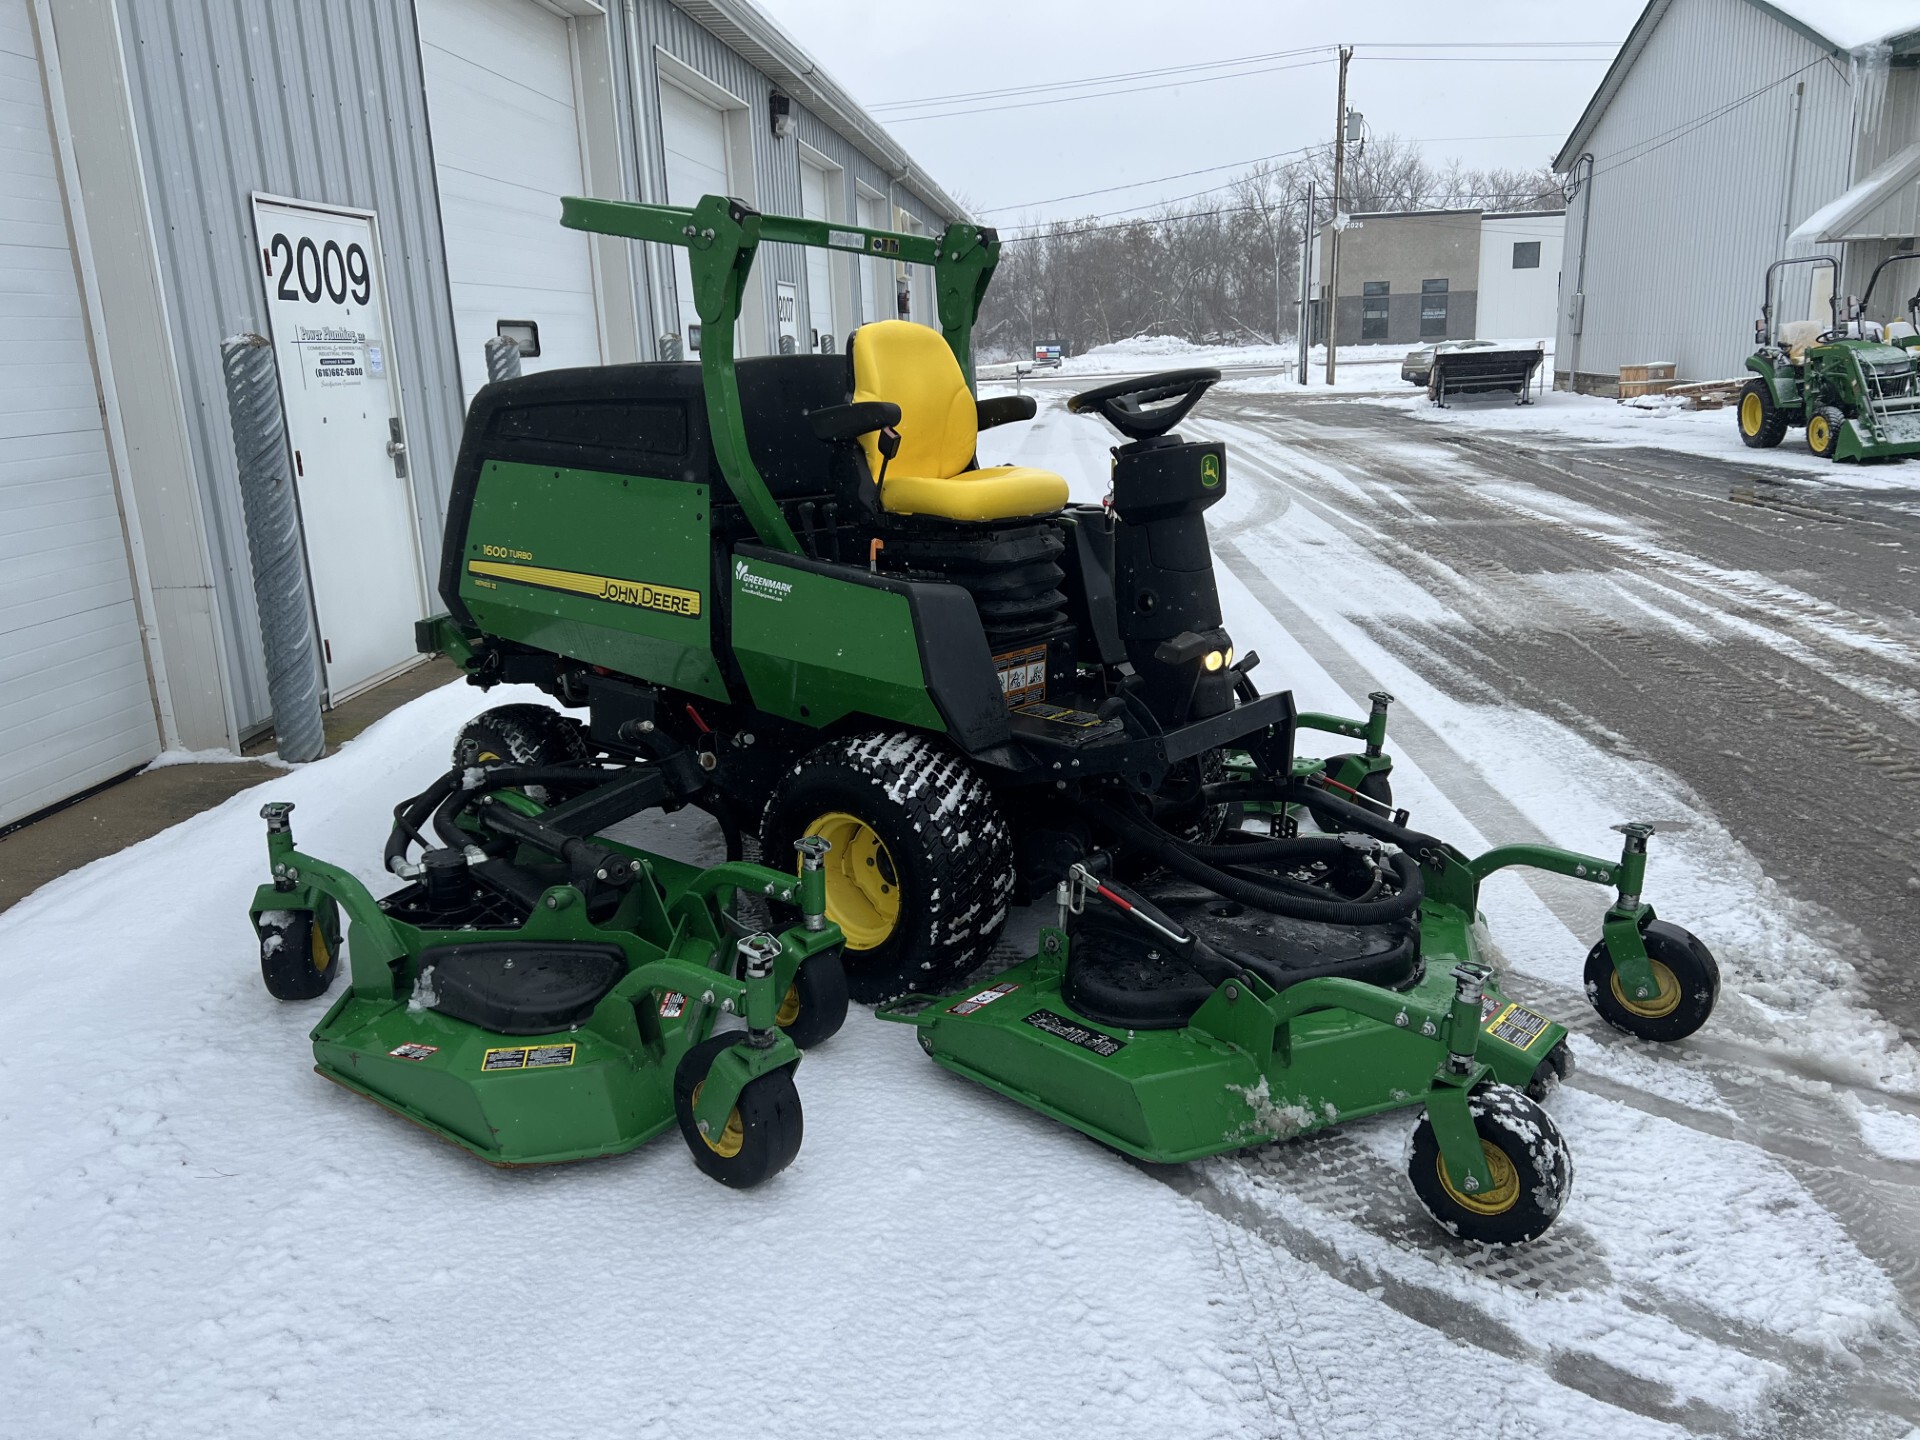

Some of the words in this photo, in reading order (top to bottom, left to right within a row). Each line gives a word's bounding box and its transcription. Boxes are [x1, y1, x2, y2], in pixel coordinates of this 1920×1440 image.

[271, 233, 370, 306] 2009
[778, 296, 793, 322] 2007
[300, 326, 322, 340] Power
[482, 544, 508, 558] 1600
[509, 549, 533, 561] TURBO
[742, 573, 793, 593] GREENMARK
[600, 580, 638, 602] JOHN
[641, 587, 691, 612] DEERE
